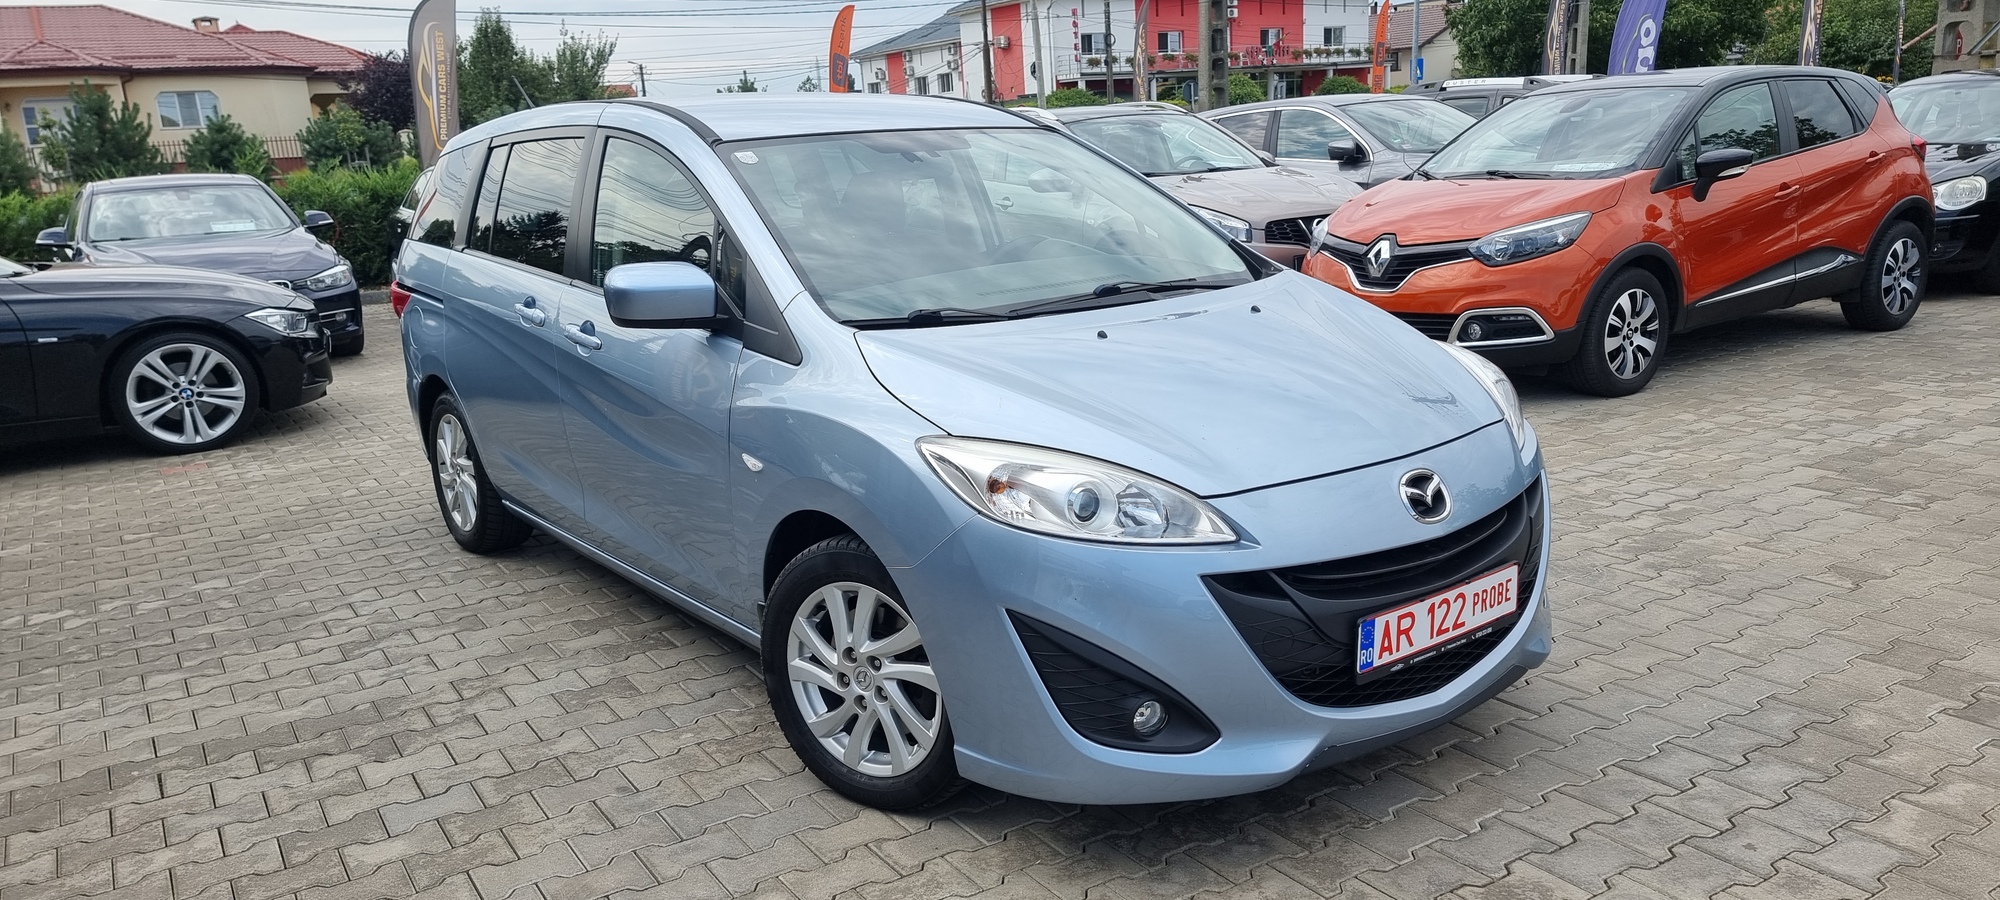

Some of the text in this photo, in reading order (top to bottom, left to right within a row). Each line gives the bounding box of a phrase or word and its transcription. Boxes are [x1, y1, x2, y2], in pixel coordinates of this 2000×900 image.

[838, 16, 847, 49] bank
[436, 31, 448, 140] PREMIUM CARS WEST
[1378, 578, 1513, 660] AR 122 PROBE
[1360, 647, 1373, 666] RO
